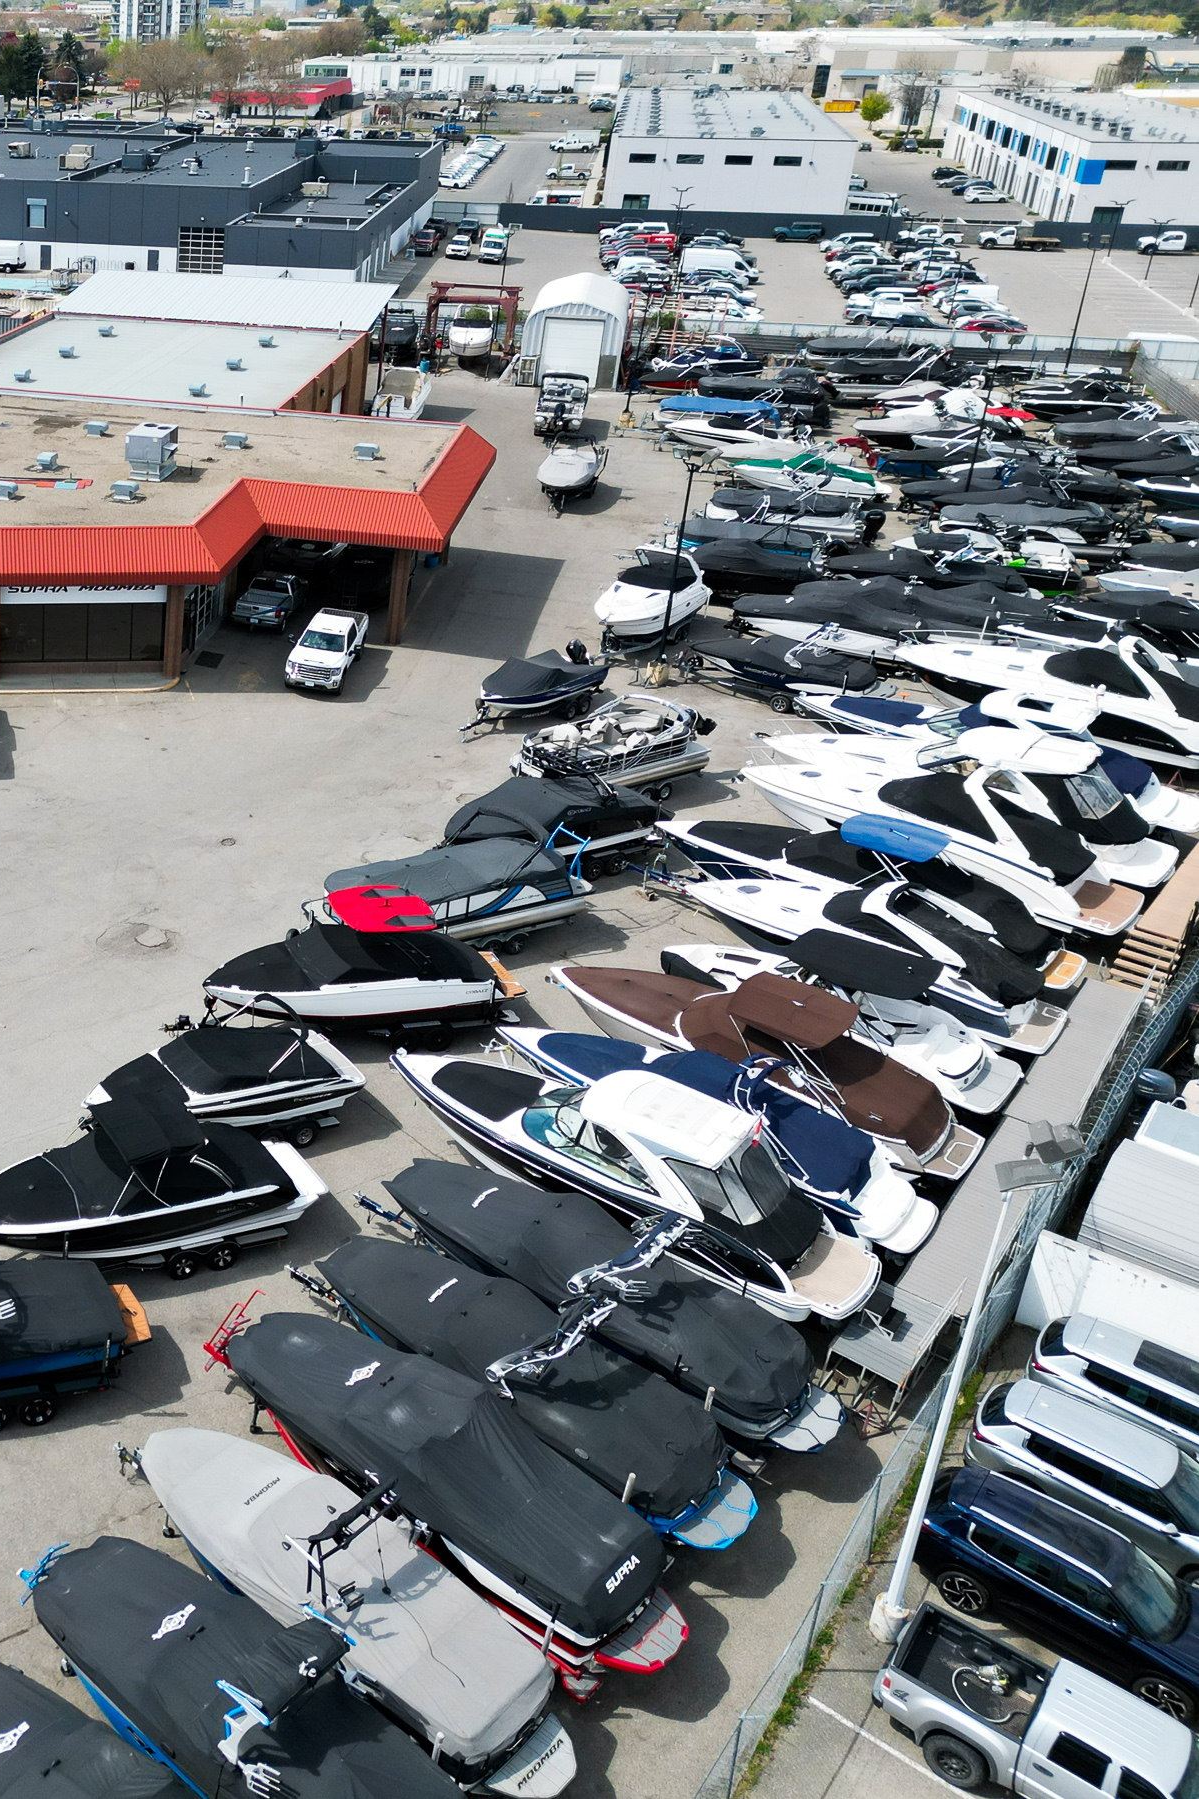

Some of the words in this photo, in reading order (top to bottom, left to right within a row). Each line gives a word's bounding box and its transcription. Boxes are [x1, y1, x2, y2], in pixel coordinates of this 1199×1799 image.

[244, 1476, 280, 1506] MOOMBA
[606, 1554, 640, 1594] SUPRA
[517, 1738, 564, 1791] MOOMBA
